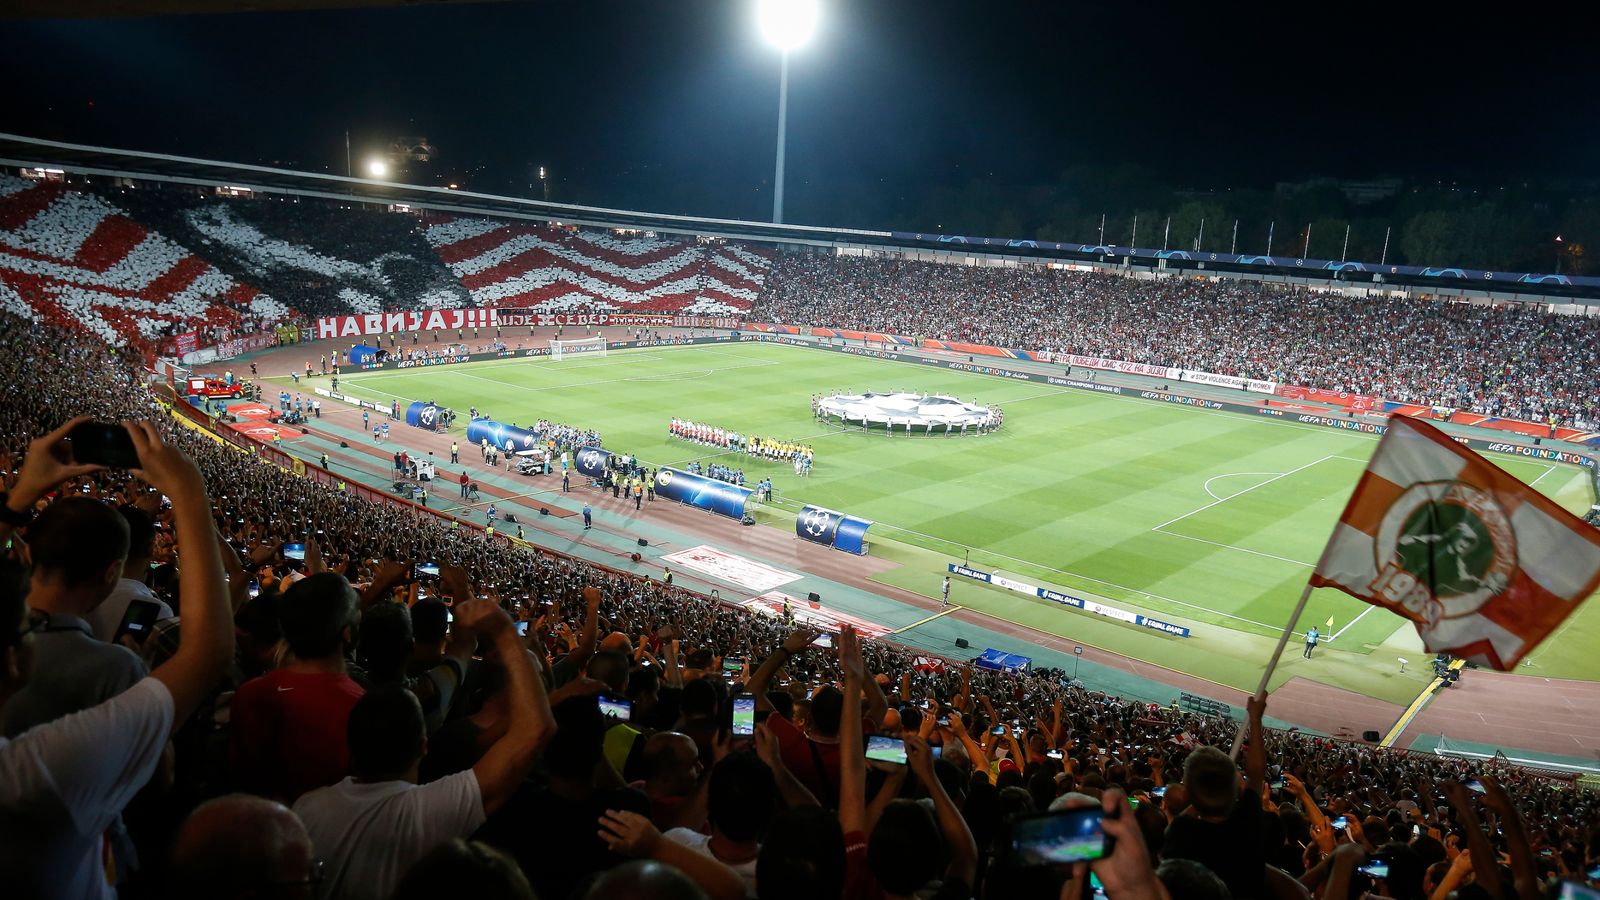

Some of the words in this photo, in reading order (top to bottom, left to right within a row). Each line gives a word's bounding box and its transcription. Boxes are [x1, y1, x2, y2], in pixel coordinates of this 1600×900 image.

[649, 338, 686, 347] FOUNDATION
[854, 347, 890, 359] FOUNDATION
[398, 360, 415, 368] UEFA
[416, 355, 460, 367] FOUNDATION
[949, 362, 963, 370] UEFA
[963, 364, 1005, 376] FOUNDATION
[1067, 380, 1094, 389] CHAMPIONS
[1094, 384, 1113, 392] LEAGUE
[1253, 381, 1272, 391] WOMEN
[1141, 391, 1159, 400] UEFA
[1160, 393, 1211, 407] FOUNDATION
[1299, 414, 1320, 424] UEFA
[1321, 417, 1382, 434] FOUNDATION
[1488, 442, 1514, 453] UEFA
[1516, 446, 1587, 465] FOUNDATION
[1166, 624, 1184, 635] GAME
